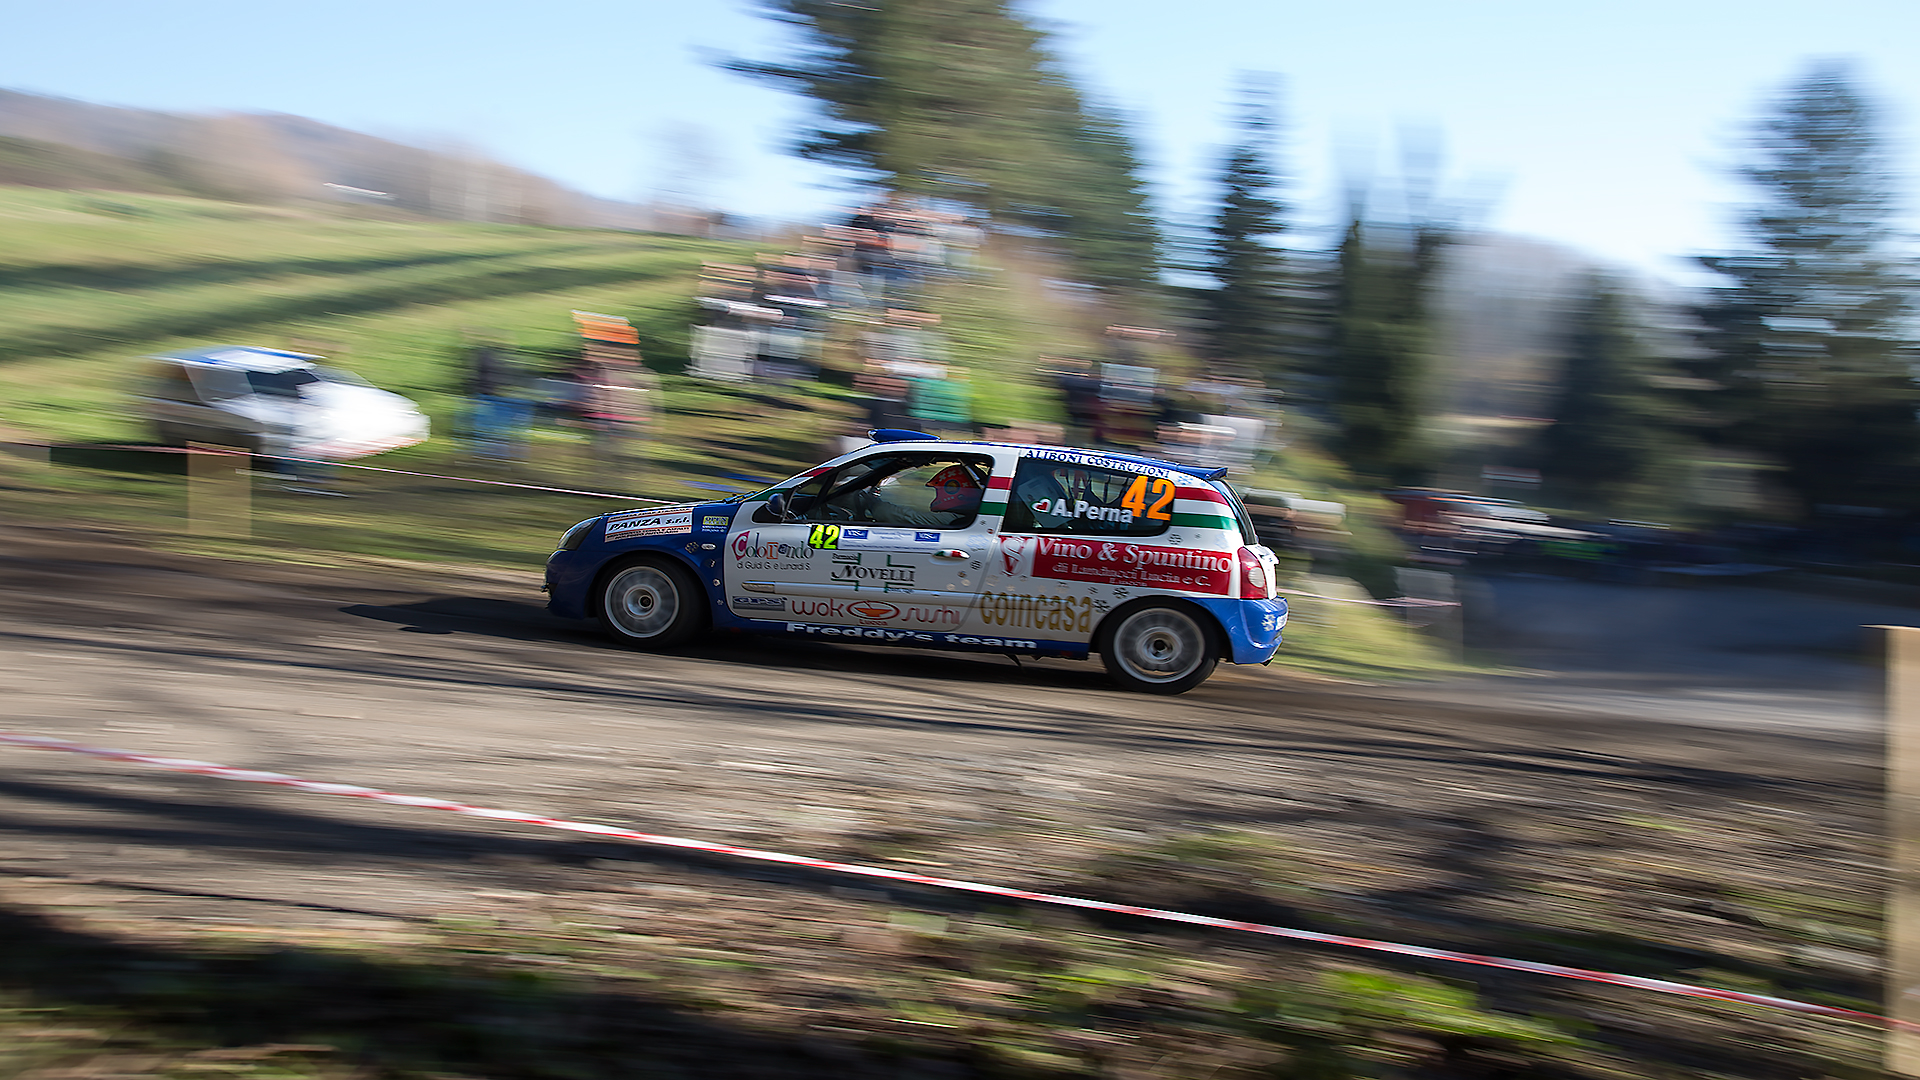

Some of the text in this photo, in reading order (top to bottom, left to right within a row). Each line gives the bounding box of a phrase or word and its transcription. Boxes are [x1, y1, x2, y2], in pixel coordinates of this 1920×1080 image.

[1026, 450, 1170, 479] ALIBONI COSTRUZIONI
[1121, 475, 1176, 521] 42
[608, 516, 690, 531] PANZA s.r.l.
[809, 524, 840, 549] 42
[1037, 536, 1092, 560] Vino
[1097, 542, 1119, 562] &
[1123, 544, 1234, 573] Spuntino
[831, 565, 915, 582] NOVELLI
[1182, 577, 1193, 585] e
[791, 598, 960, 625] wok sushi
[979, 590, 1092, 633] coincasa
[786, 622, 1038, 649] Freddy's team
